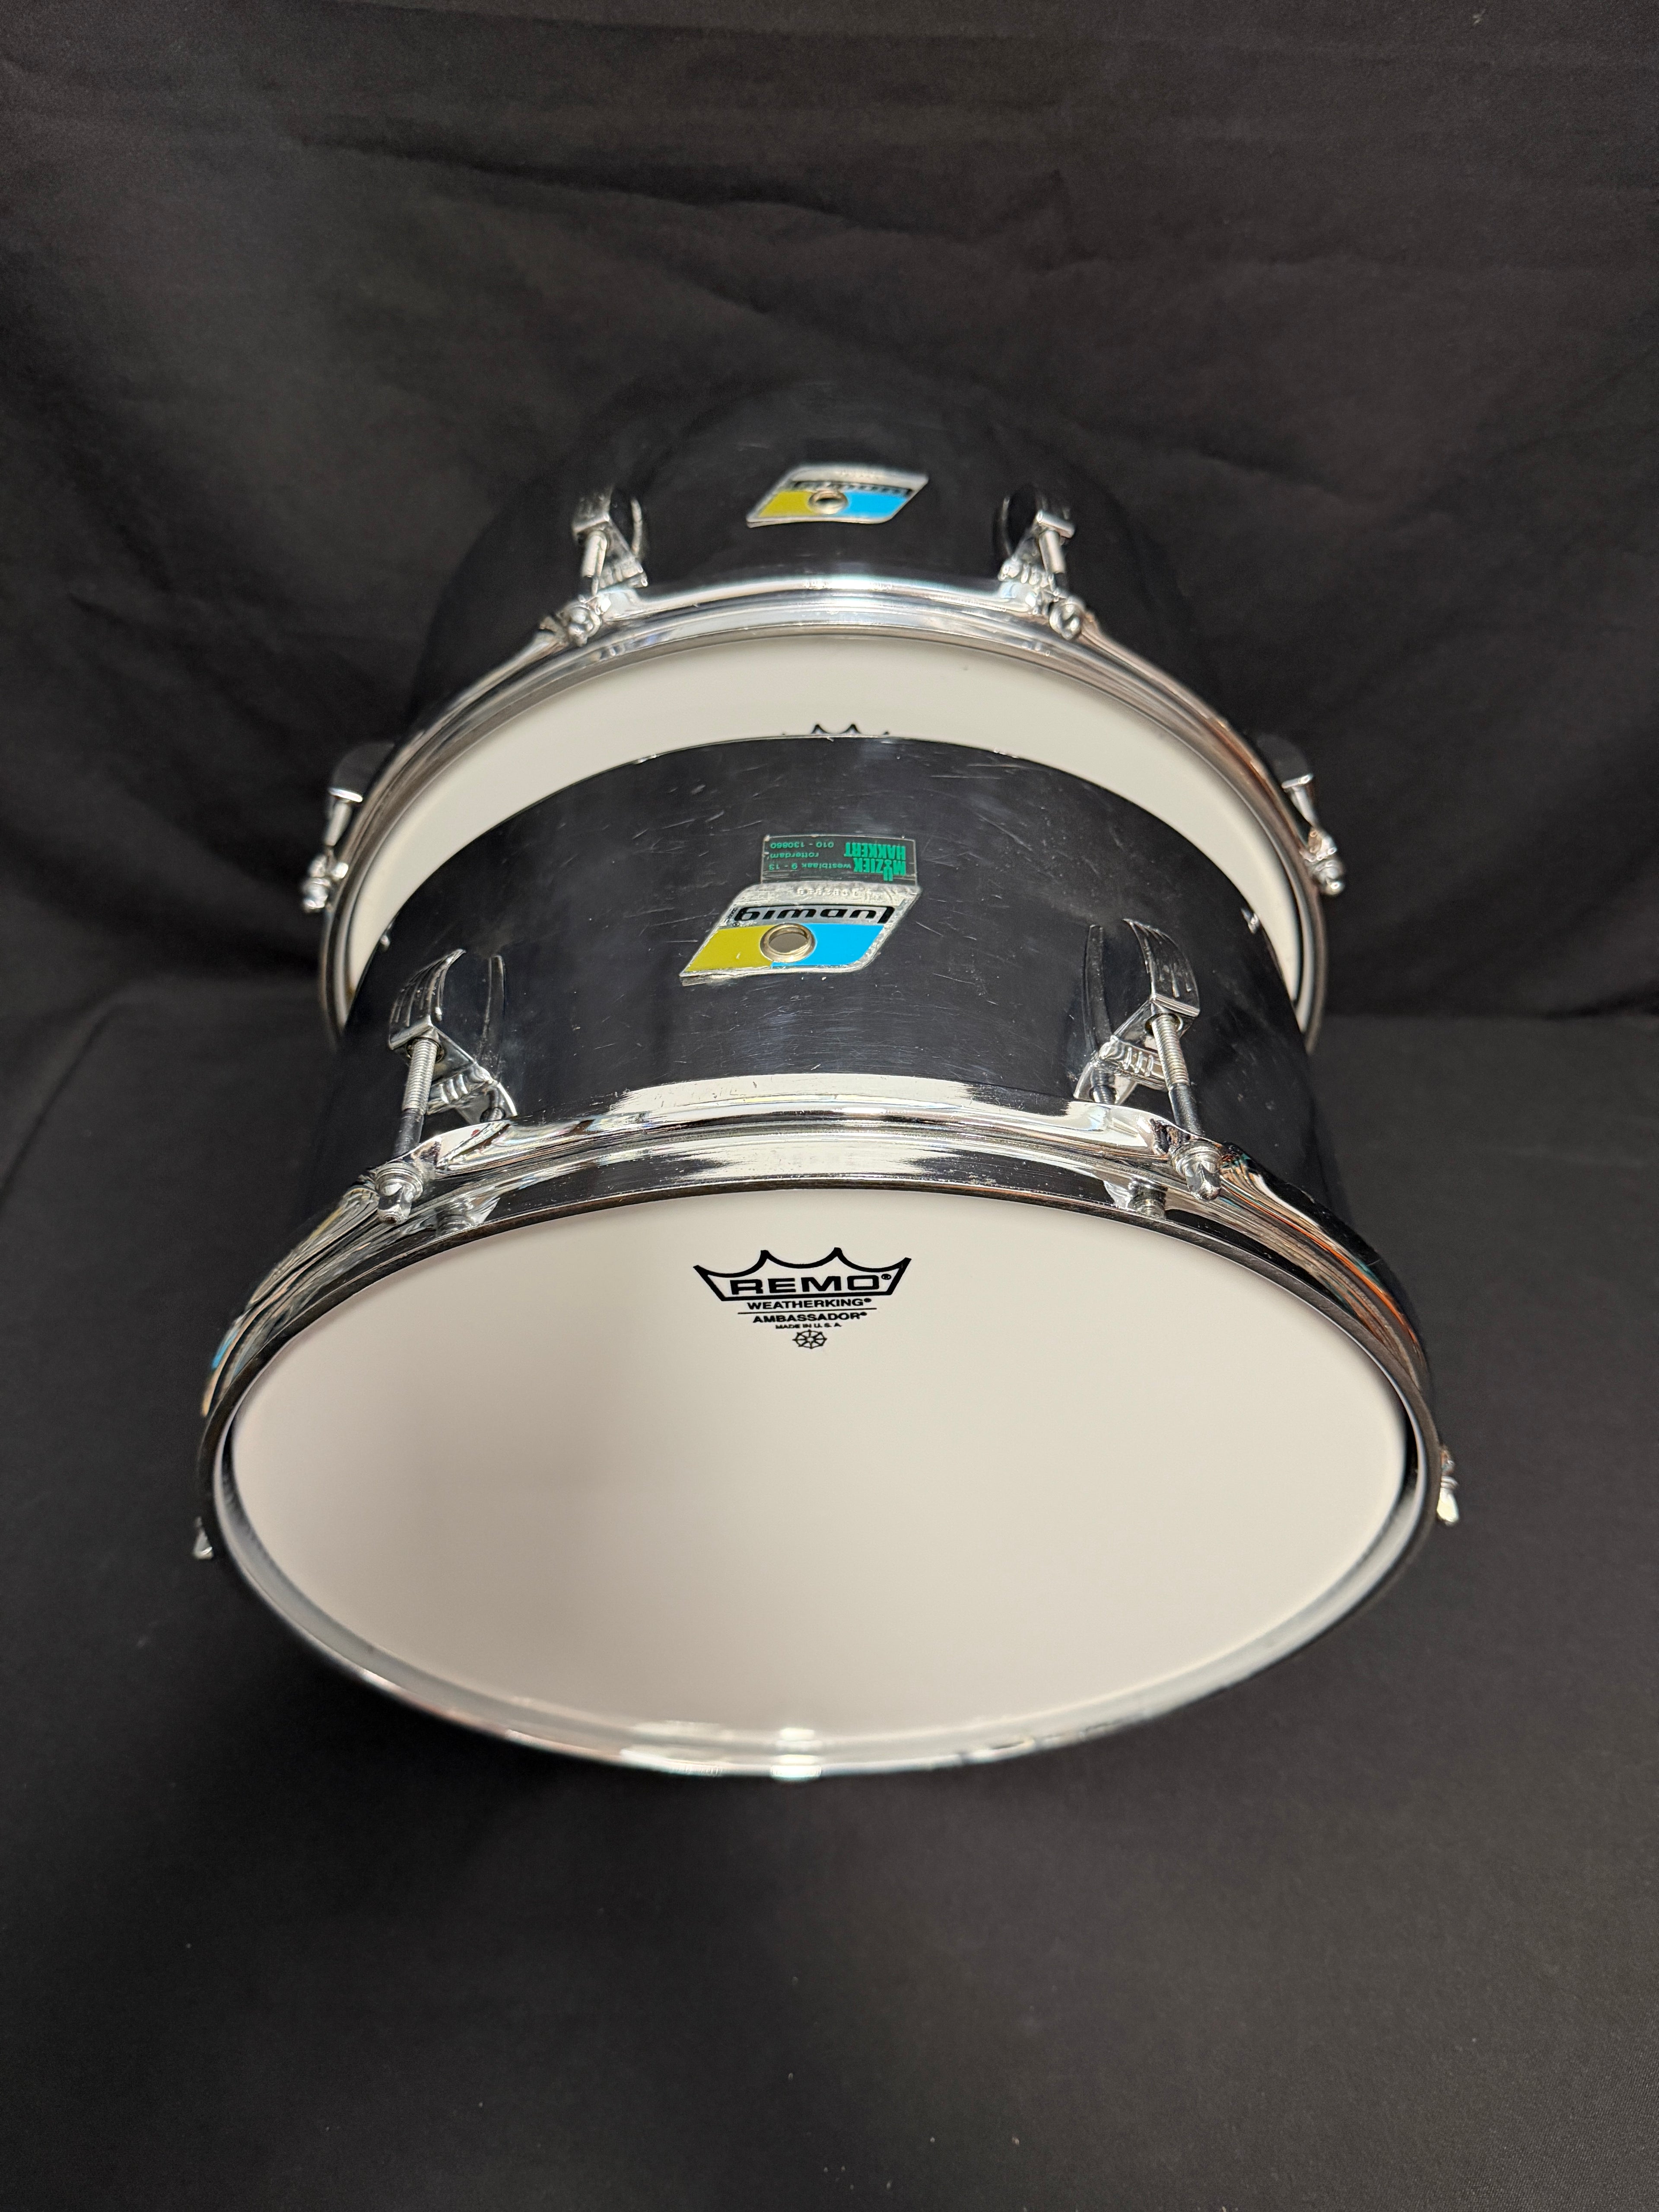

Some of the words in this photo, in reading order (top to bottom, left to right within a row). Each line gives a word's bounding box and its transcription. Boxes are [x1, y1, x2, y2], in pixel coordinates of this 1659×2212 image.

[844, 842, 906, 860] HAKKERT
[853, 857, 906, 881] MUZIEK
[730, 1275, 879, 1294] REMO
[747, 1298, 863, 1309] WEATHERKING
[753, 1313, 860, 1323] AMBASSADOR
